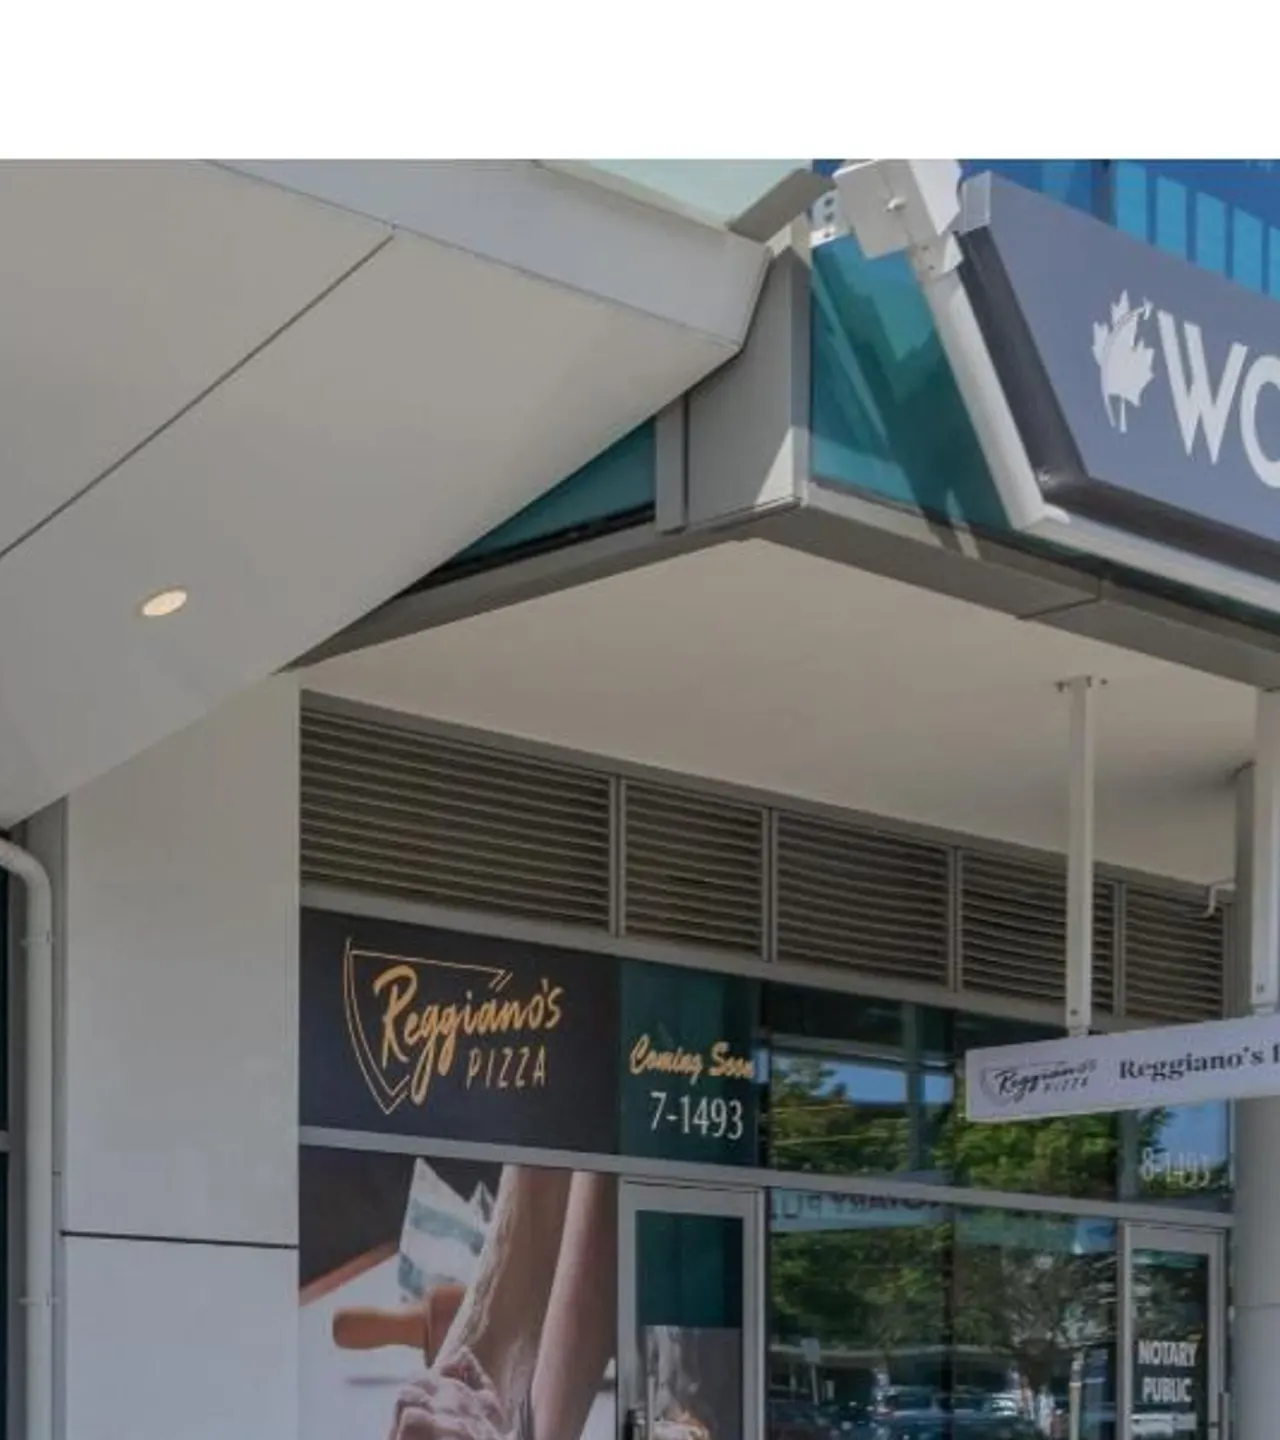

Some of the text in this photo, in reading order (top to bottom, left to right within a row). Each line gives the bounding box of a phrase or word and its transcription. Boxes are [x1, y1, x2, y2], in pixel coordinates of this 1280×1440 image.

[373, 964, 563, 1106] Reggiano's
[466, 1045, 548, 1090] PIZZA
[630, 1033, 755, 1086] Coming Soon
[1119, 1045, 1266, 1082] Reggiano's
[649, 1090, 744, 1140] 7-1493
[1137, 1340, 1198, 1367] NOTARY
[1142, 1376, 1192, 1403] PUBLIC
